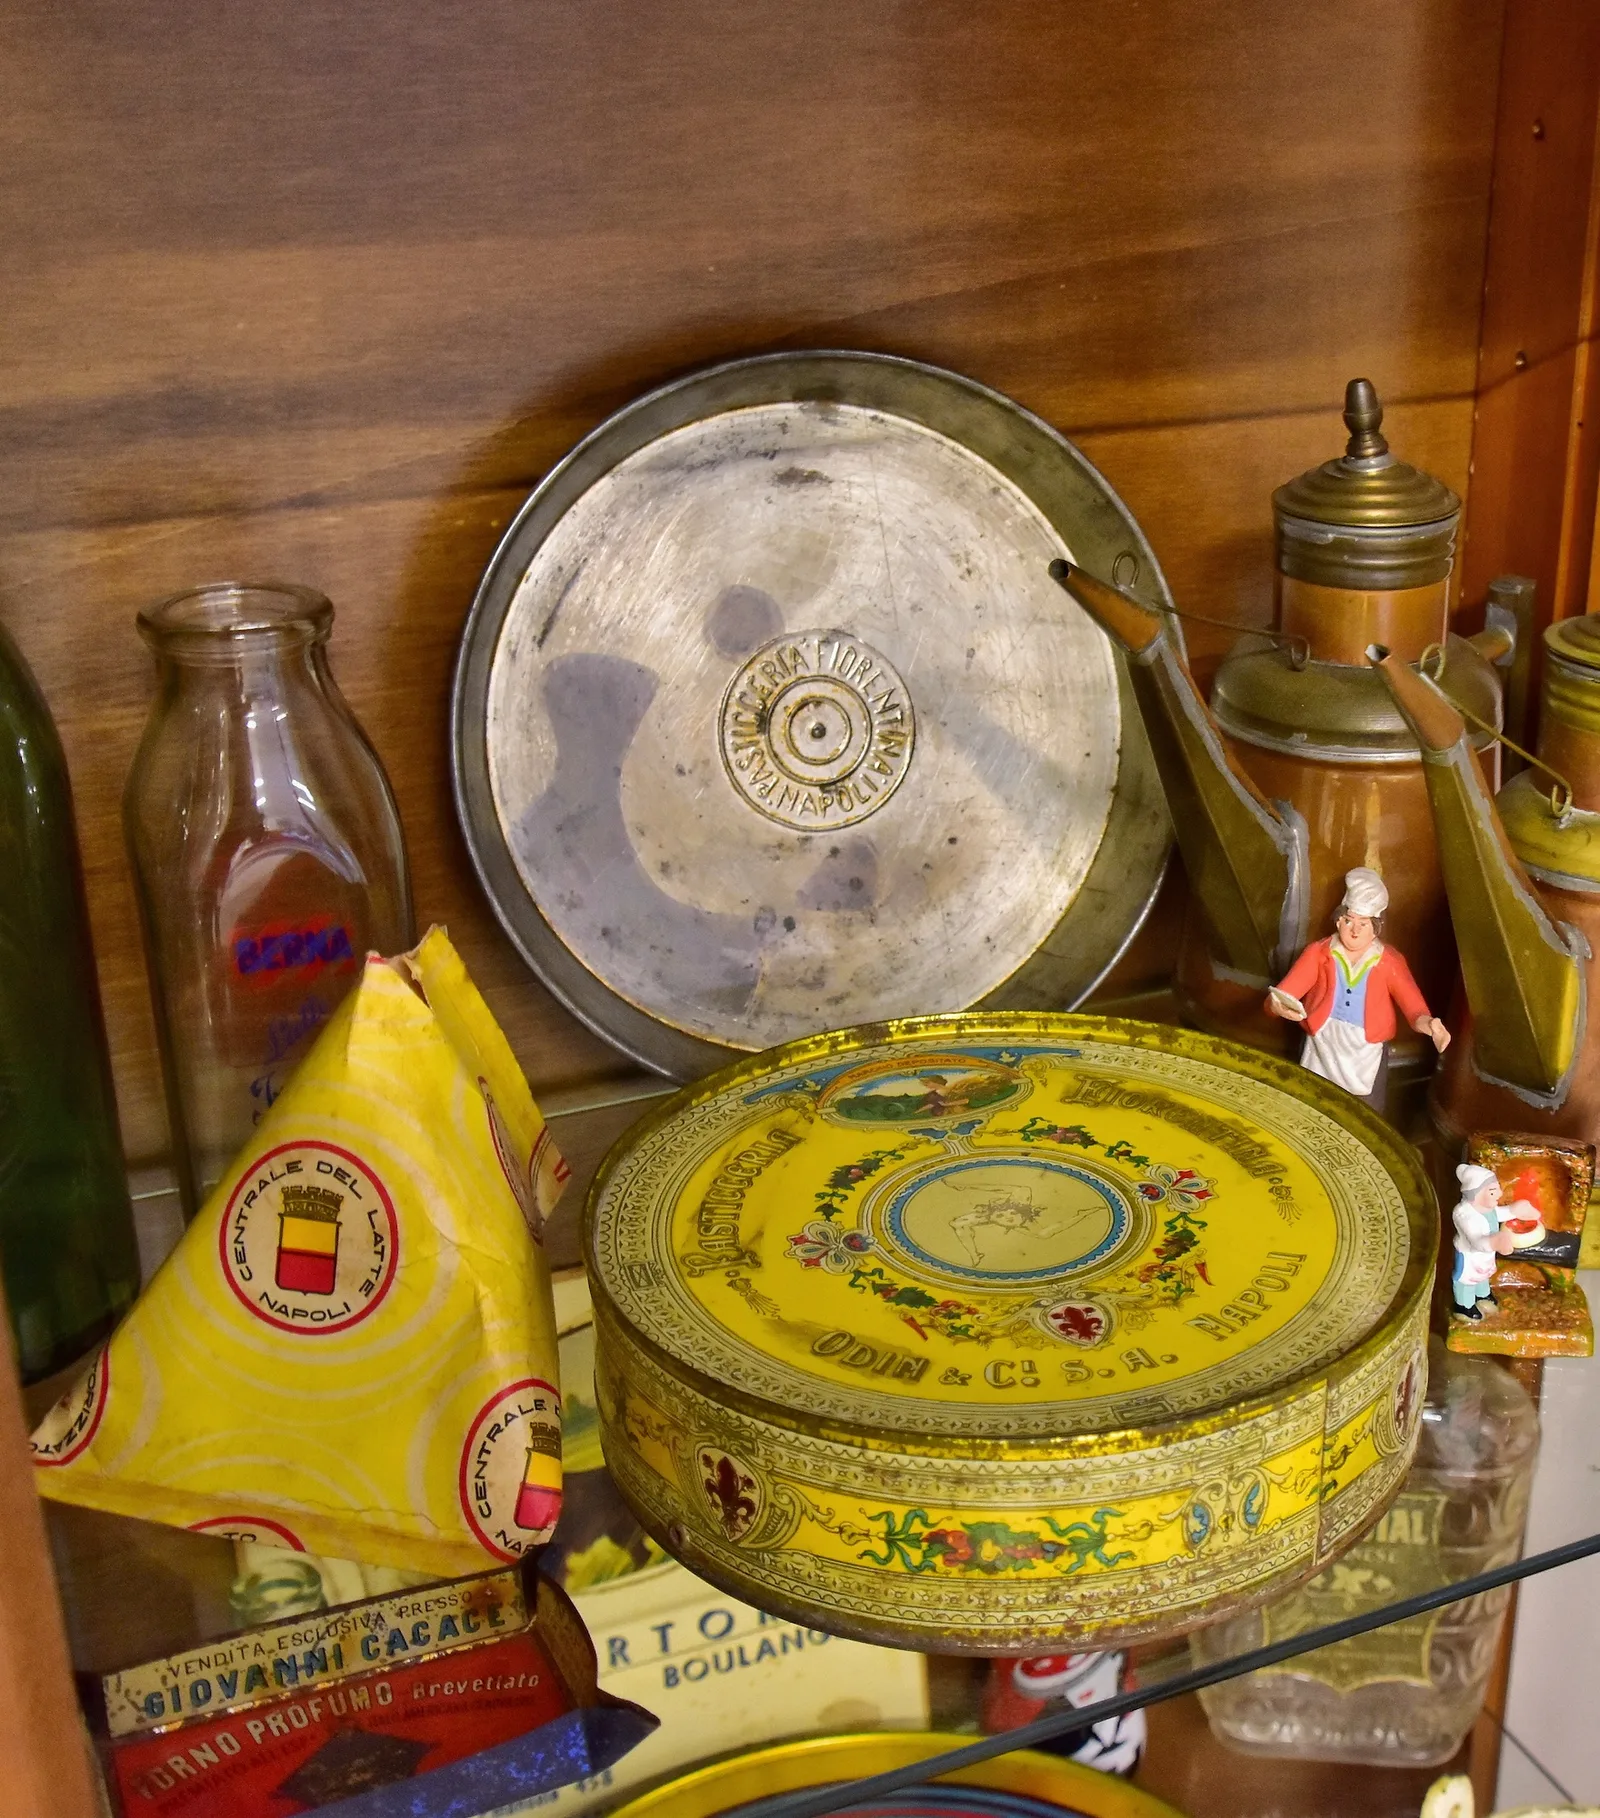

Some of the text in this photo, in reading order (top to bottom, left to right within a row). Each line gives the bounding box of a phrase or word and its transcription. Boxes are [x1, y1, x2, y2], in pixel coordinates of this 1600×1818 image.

[776, 773, 879, 819] NAPOLI
[233, 1160, 386, 1298] CENTRALE DEL LATTE
[681, 1129, 806, 1277] PASTICCERIA
[259, 1291, 352, 1323] NAPOLI
[1183, 1251, 1307, 1342] NAPOLI
[812, 1330, 931, 1384] ODIN
[938, 1366, 973, 1386] &
[474, 1398, 548, 1519] CENTRALE
[1363, 1510, 1429, 1545] IAL
[144, 1643, 345, 1720] GIOVANNI
[360, 1601, 507, 1662] CACACE
[168, 1642, 266, 1679] VENDITA
[277, 1611, 386, 1651] ESCLUSIVA
[245, 1681, 394, 1745] PROFUMO
